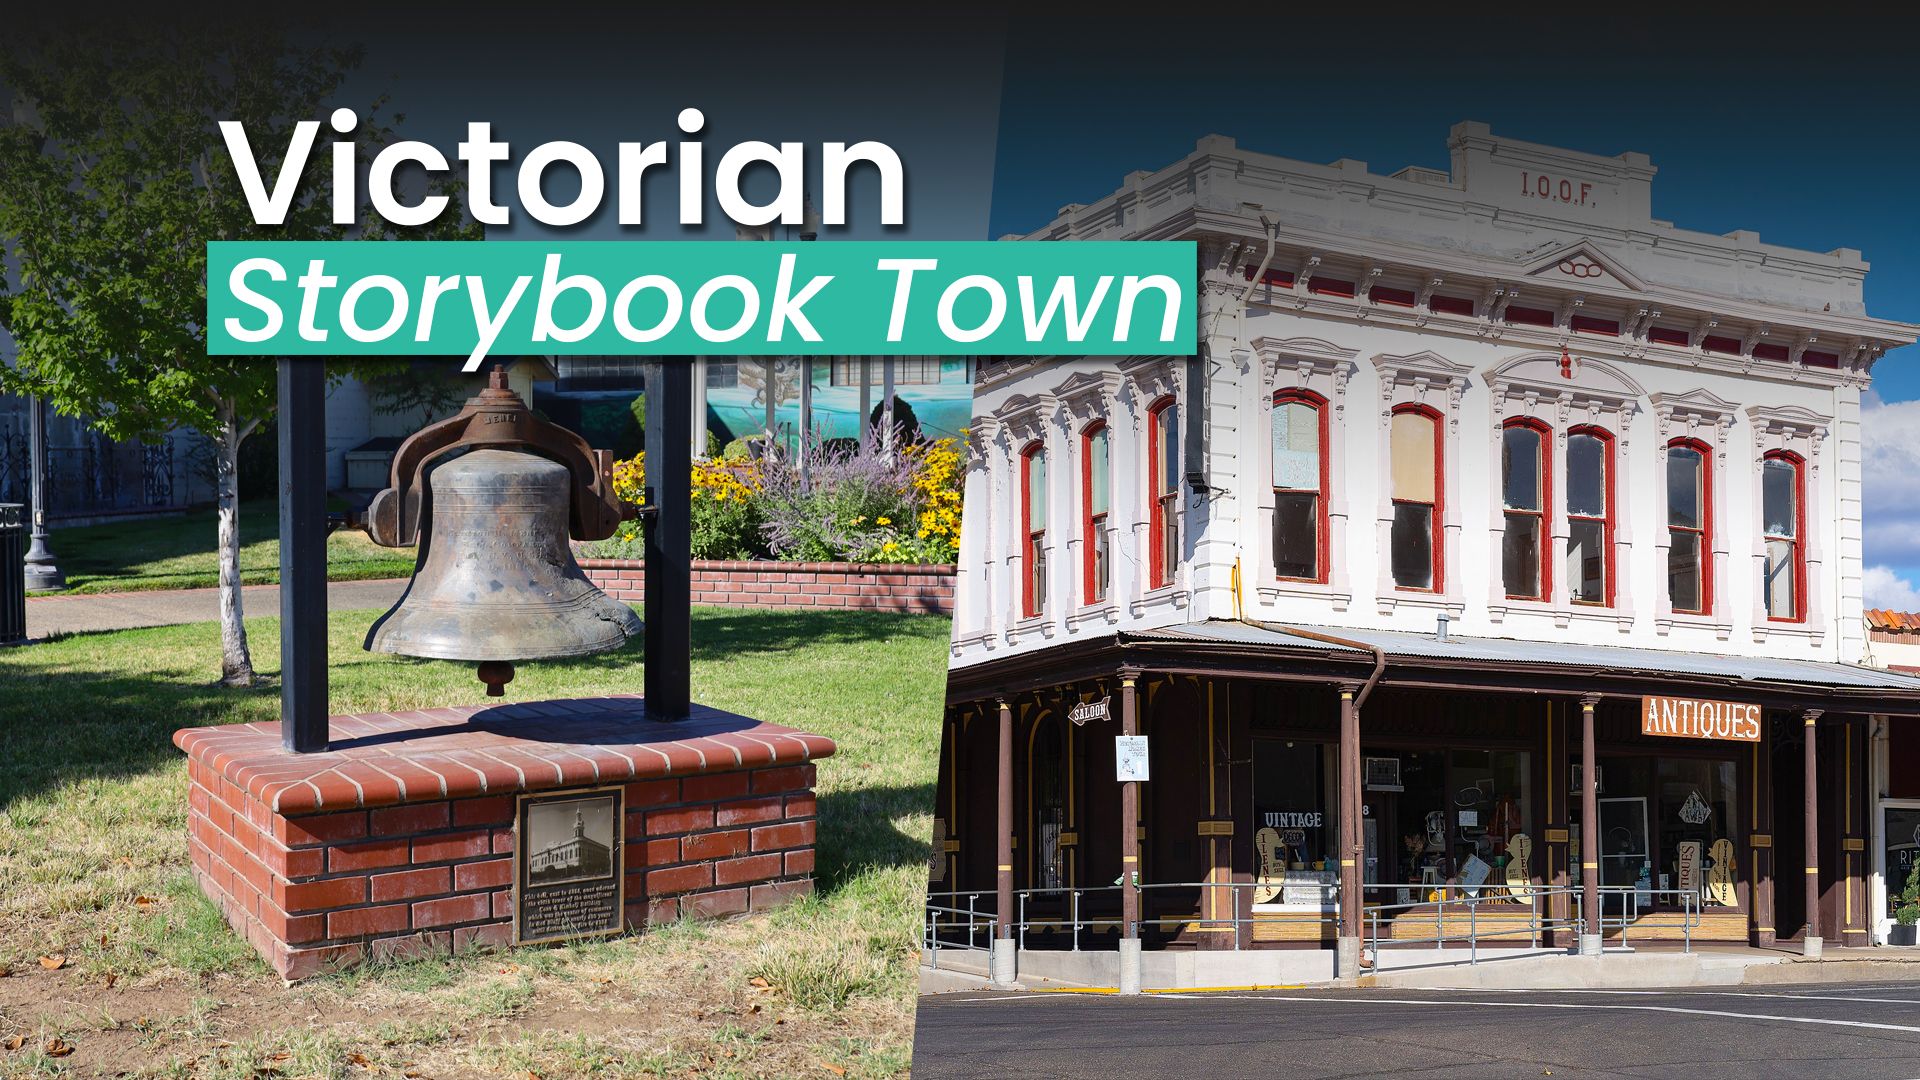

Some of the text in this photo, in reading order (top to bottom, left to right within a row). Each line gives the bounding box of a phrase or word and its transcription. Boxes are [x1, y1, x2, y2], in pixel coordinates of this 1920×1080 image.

[1520, 171, 1597, 208] I.O.O.F.
[1074, 703, 1107, 721] SALOON
[1645, 698, 1760, 739] ANTIQUES
[1721, 840, 1729, 901] VINTAGE
